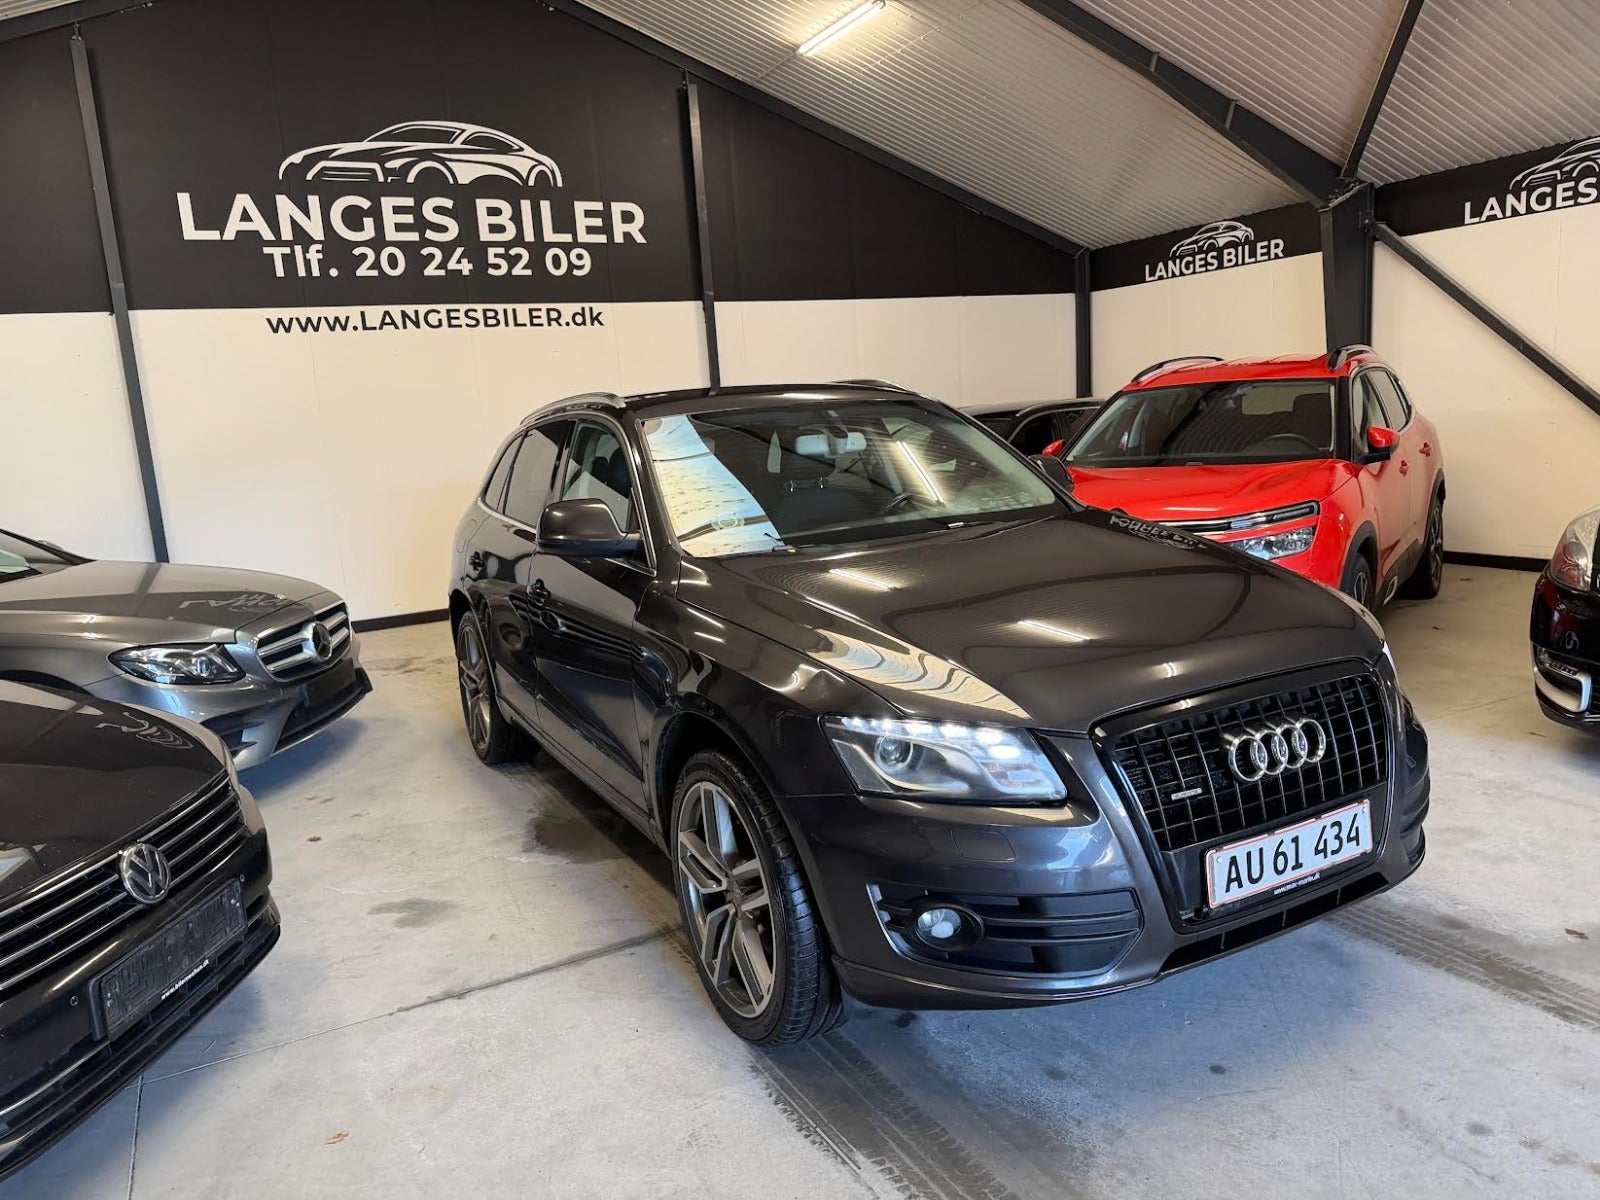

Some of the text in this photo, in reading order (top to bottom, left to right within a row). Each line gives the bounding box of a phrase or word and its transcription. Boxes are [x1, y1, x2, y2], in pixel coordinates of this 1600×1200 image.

[177, 193, 648, 243] LANGES BILER
[1464, 177, 1598, 224] LANGES
[263, 244, 592, 277] Tlf. 20 24 52 09
[1145, 238, 1284, 281] LANGES BILER
[265, 307, 604, 334] www.LANGESBILER.dk
[1225, 846, 1265, 893] AU
[1273, 834, 1303, 876] 61
[1314, 812, 1360, 859] 434
